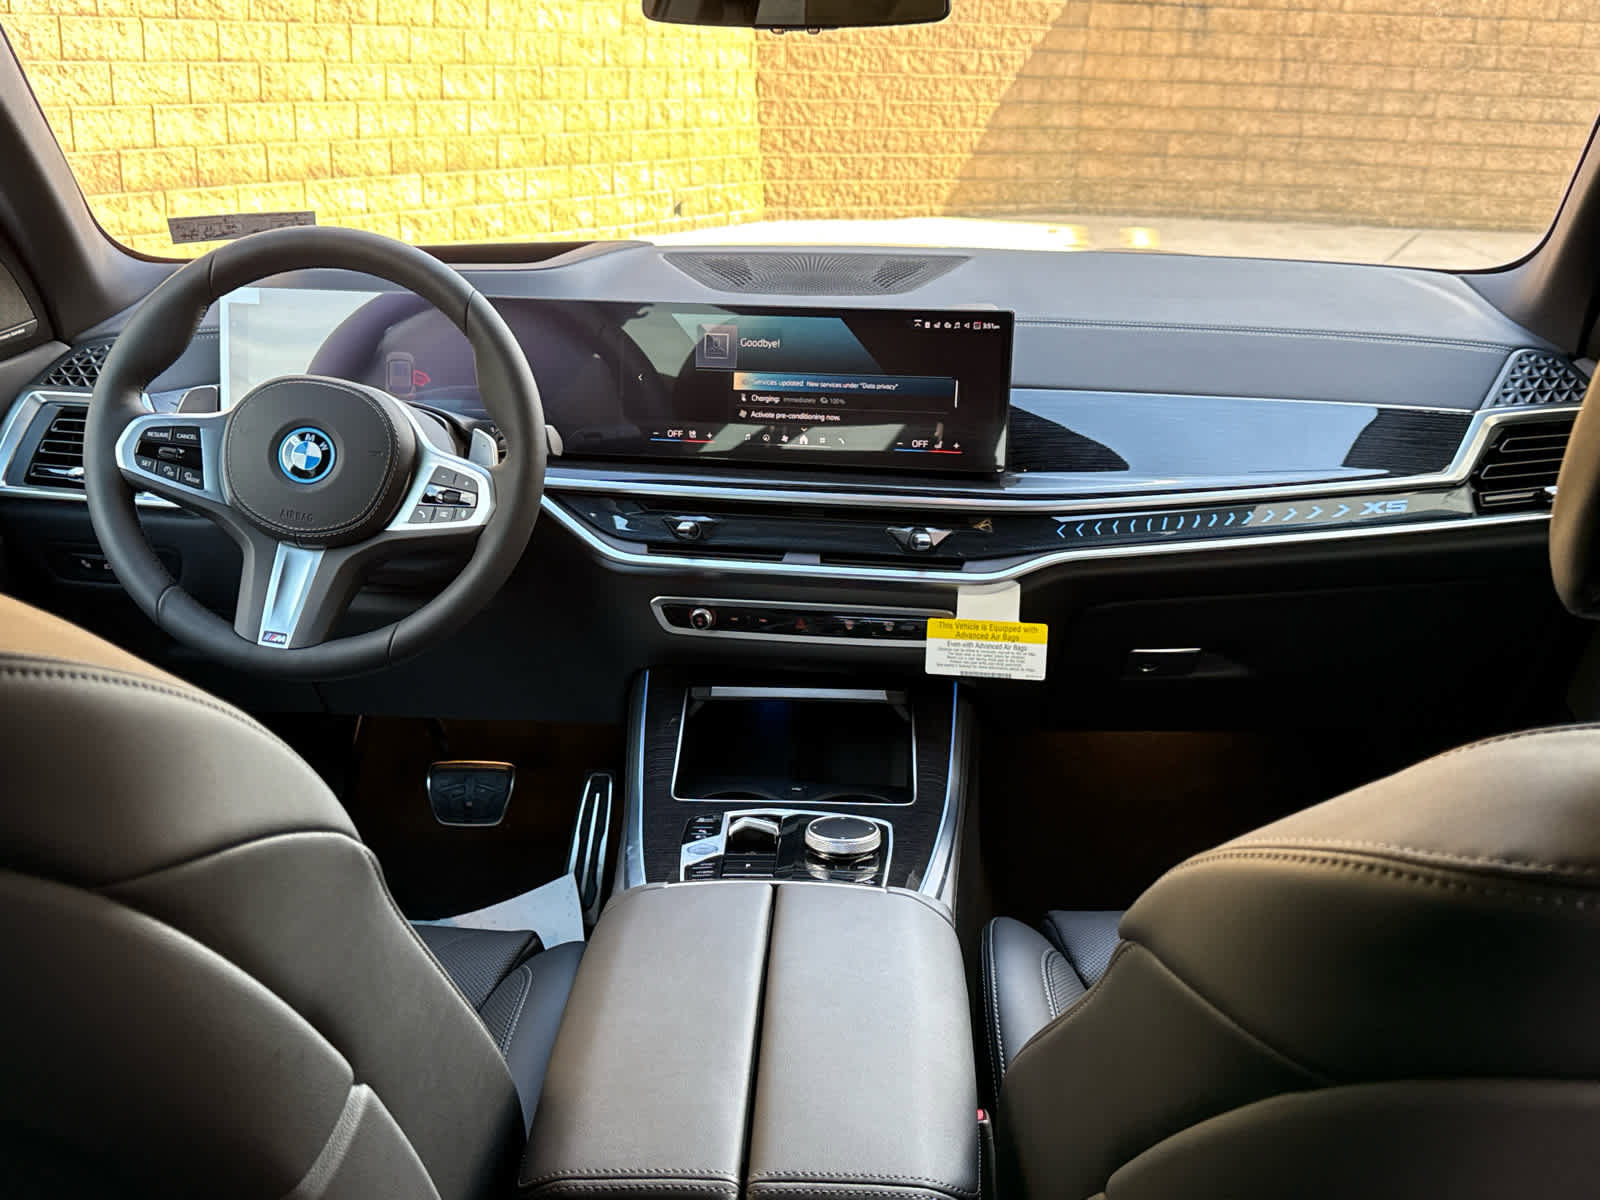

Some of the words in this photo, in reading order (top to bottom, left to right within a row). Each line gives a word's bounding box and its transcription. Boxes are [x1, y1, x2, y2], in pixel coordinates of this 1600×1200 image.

[740, 337, 781, 349] Goodbye!
[751, 410, 775, 419] Activate
[776, 412, 825, 422] pre-conditioning
[176, 433, 197, 441] CANCEL
[666, 429, 684, 438] OFF
[911, 439, 929, 448] OFF
[1359, 499, 1409, 516] X5
[938, 621, 953, 629] This
[956, 621, 979, 631] Vehicle
[981, 623, 988, 631] is
[989, 624, 1021, 634] Equipped
[1023, 626, 1039, 634] with
[955, 631, 989, 640] Advanced
[991, 633, 1001, 641] Air
[1003, 633, 1020, 643] Bags
[975, 642, 1003, 650] Advanced
[1014, 644, 1028, 652] Bags
